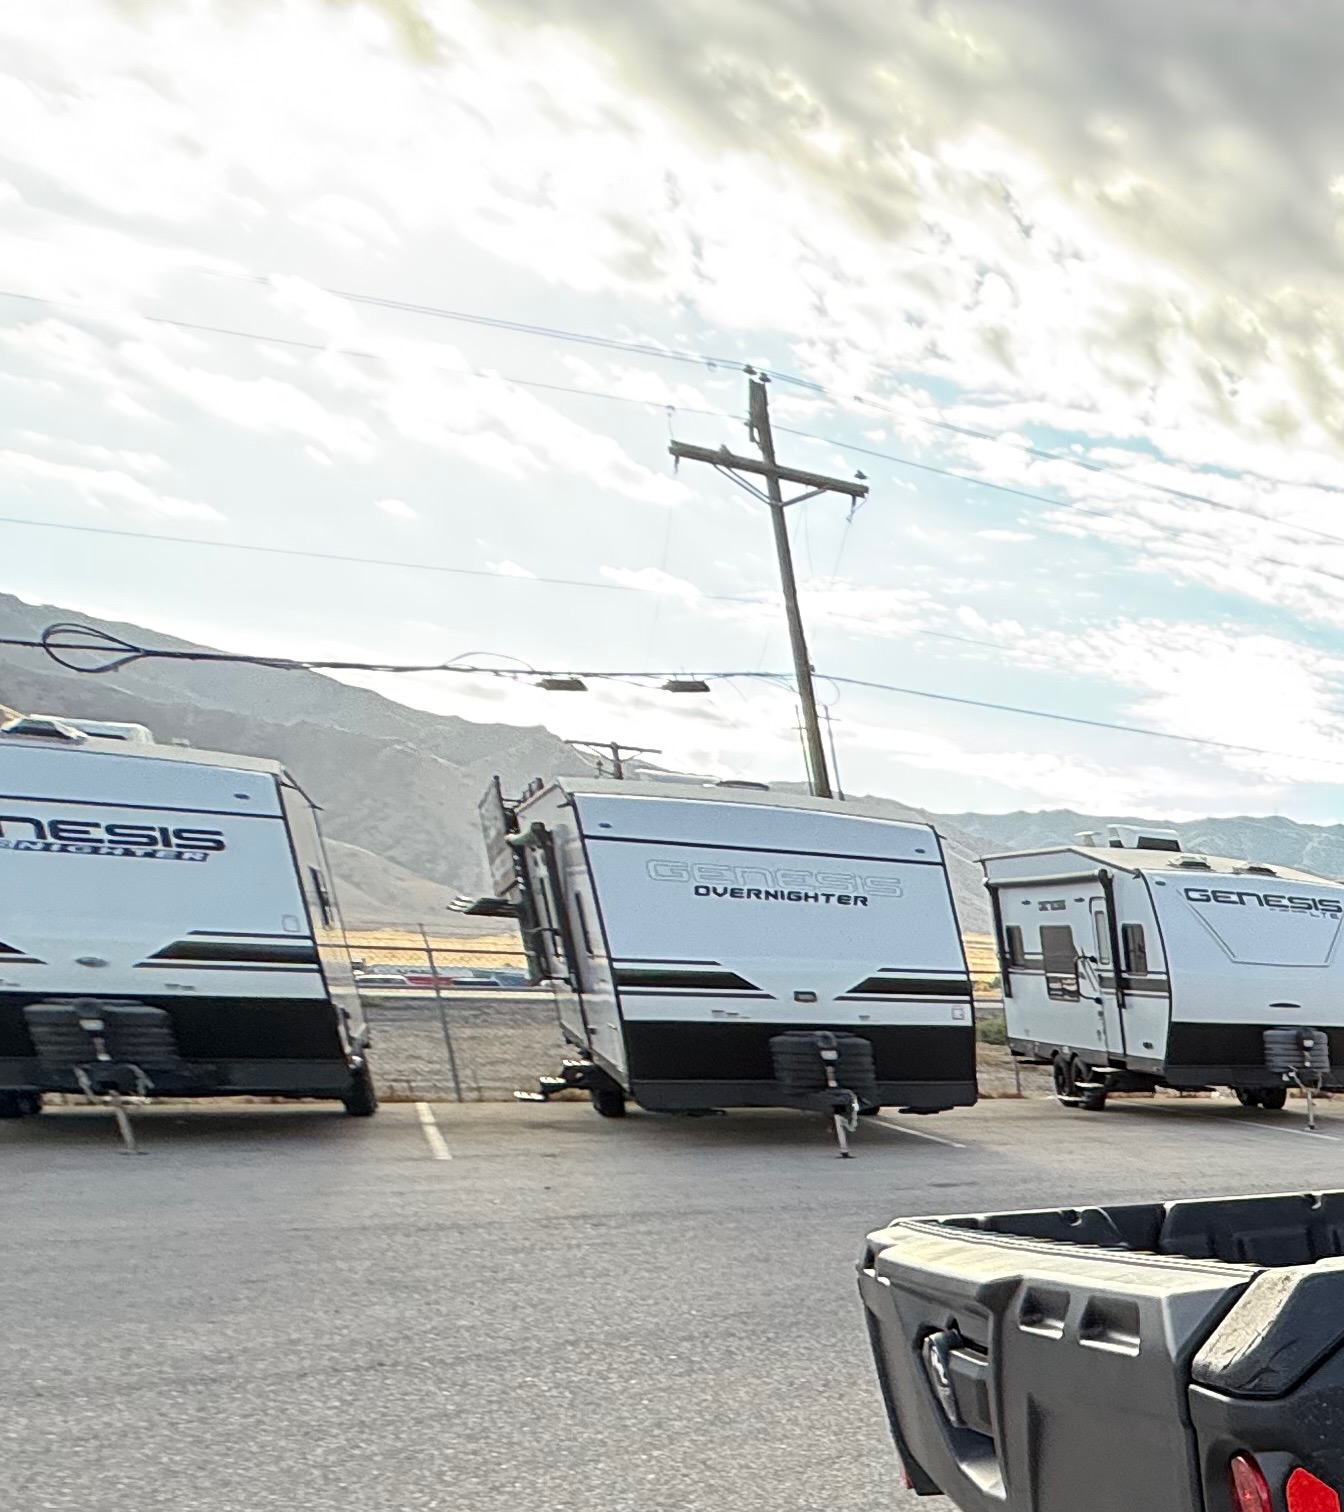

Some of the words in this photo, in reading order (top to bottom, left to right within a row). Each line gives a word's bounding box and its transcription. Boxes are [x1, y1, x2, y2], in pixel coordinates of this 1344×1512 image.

[646, 859, 903, 898] GENESIS
[694, 885, 869, 907] OVERNIGHTER
[1184, 888, 1343, 913] GENESIS
